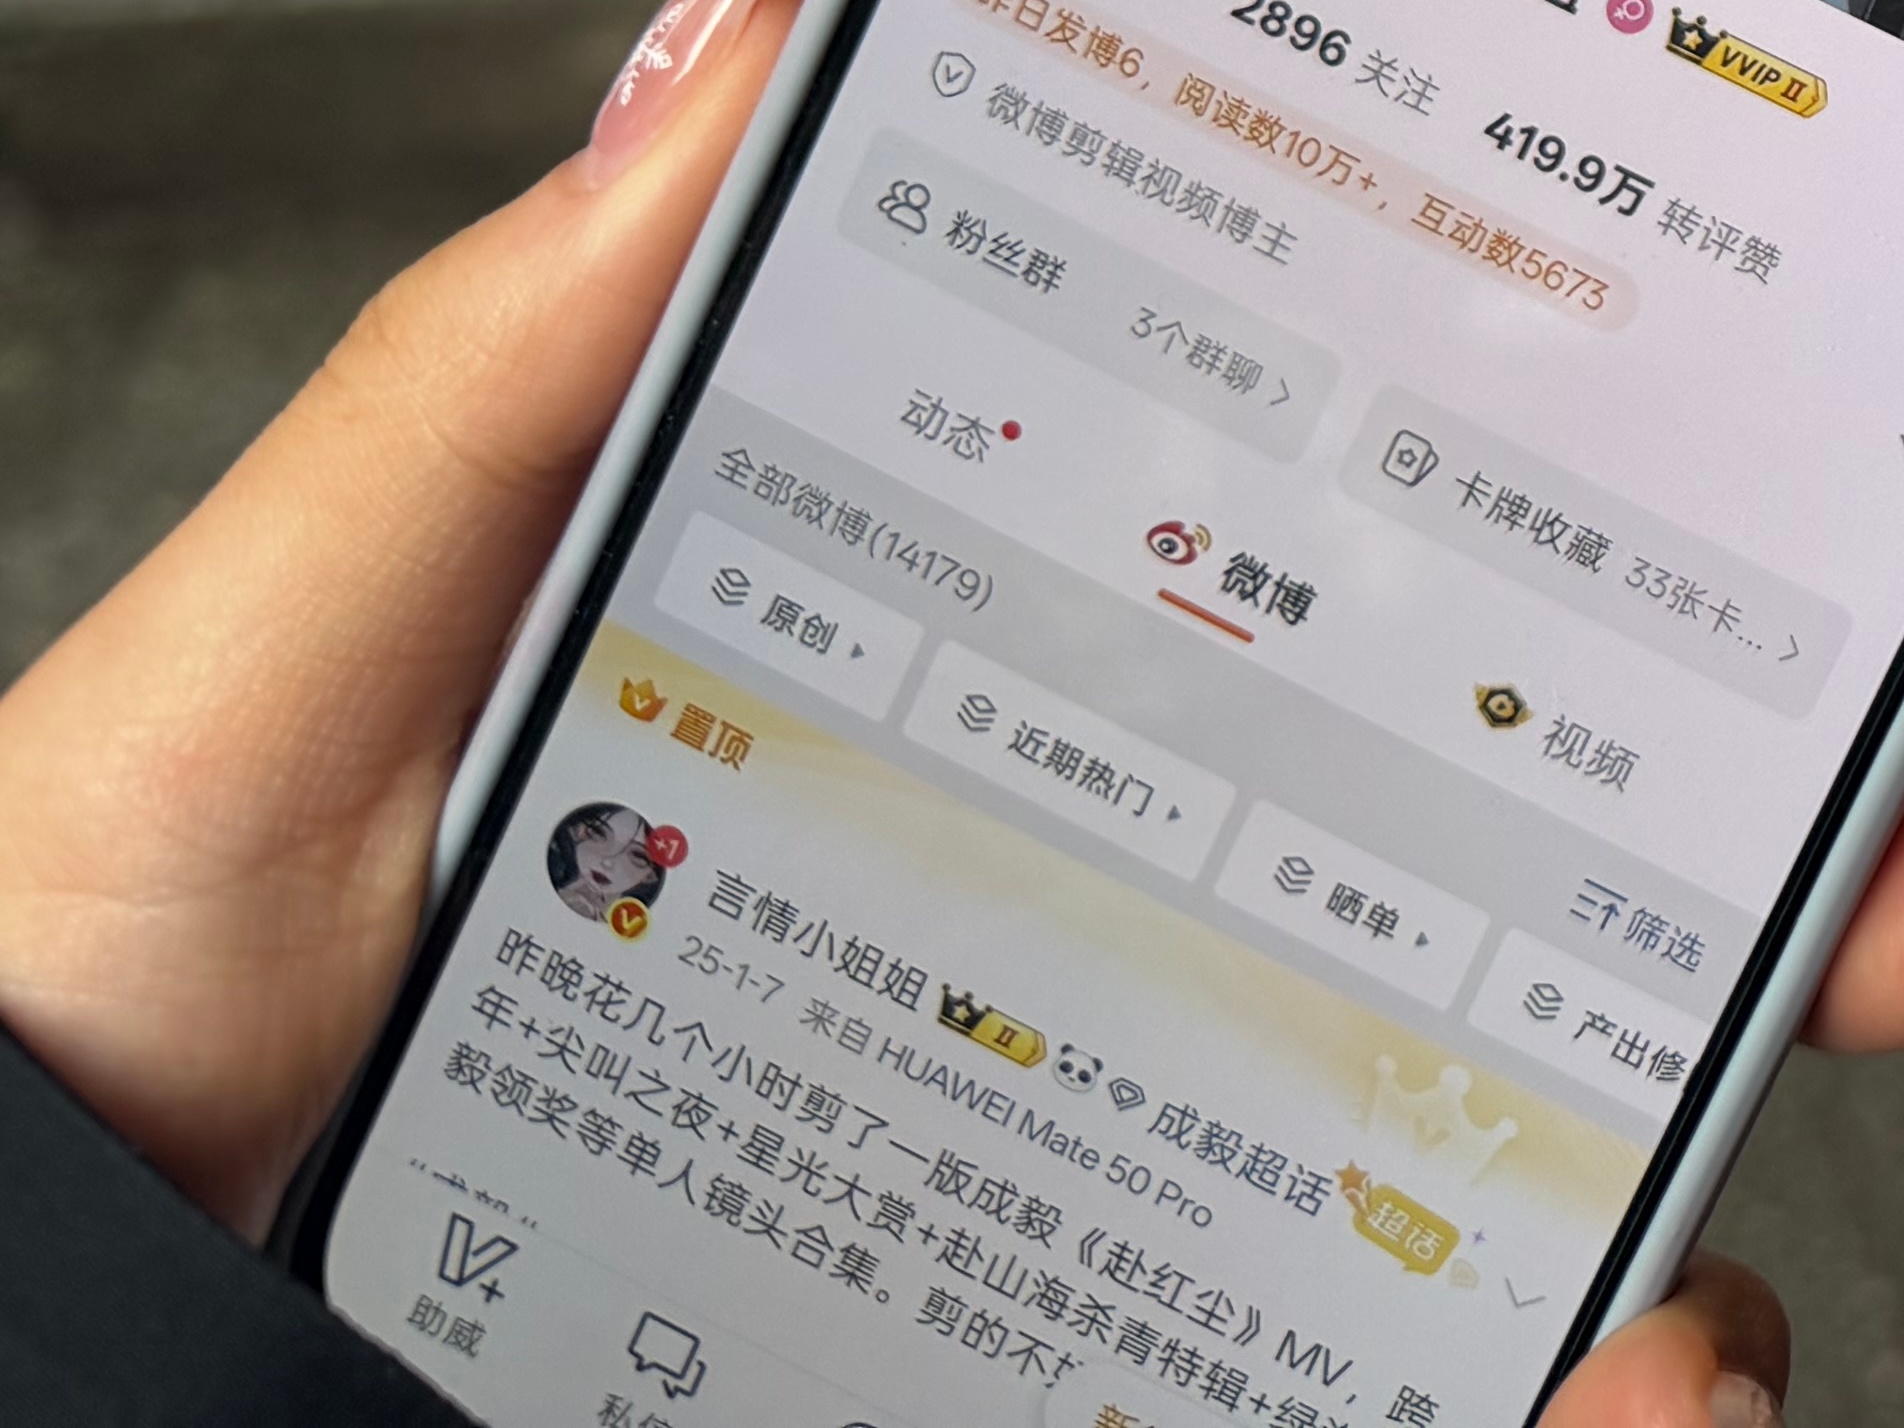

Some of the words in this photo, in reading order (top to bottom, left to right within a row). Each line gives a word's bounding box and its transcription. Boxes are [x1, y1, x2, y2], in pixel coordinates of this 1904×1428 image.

[1361, 50, 1442, 116] 关注
[1721, 45, 1781, 86] VVIP
[986, 82, 1299, 266] 微博剪辑视频博主
[1484, 112, 1656, 217] 419.9万
[1657, 197, 1783, 284] 转评赞
[945, 209, 1068, 294] 粉丝群
[1130, 306, 1264, 396] 3个群聊
[900, 387, 996, 464] 动态
[714, 447, 994, 613] 全部微博(14179)
[1455, 470, 1614, 574] 卡牌收藏
[760, 593, 839, 655] 原创
[1220, 551, 1319, 627] 微博
[669, 701, 756, 772] 置顶
[1006, 718, 1155, 819] 近期热门
[1543, 714, 1641, 794] 视频
[706, 866, 929, 1014] 言情小姐姐
[1324, 881, 1402, 943] 晒单
[1623, 904, 1707, 975] 筛选
[677, 935, 786, 1007] 25-1-7
[799, 996, 875, 1057] 来自
[876, 1038, 1016, 1127] HUAWEI
[1017, 1108, 1101, 1175] Mate
[1105, 1156, 1153, 1199] 50
[1155, 1179, 1214, 1232] Pro
[1573, 1012, 1688, 1081] 产出修
[1147, 1101, 1334, 1220] 成毅超话
[1368, 1199, 1446, 1262] 超话
[406, 1293, 487, 1358] 助威
